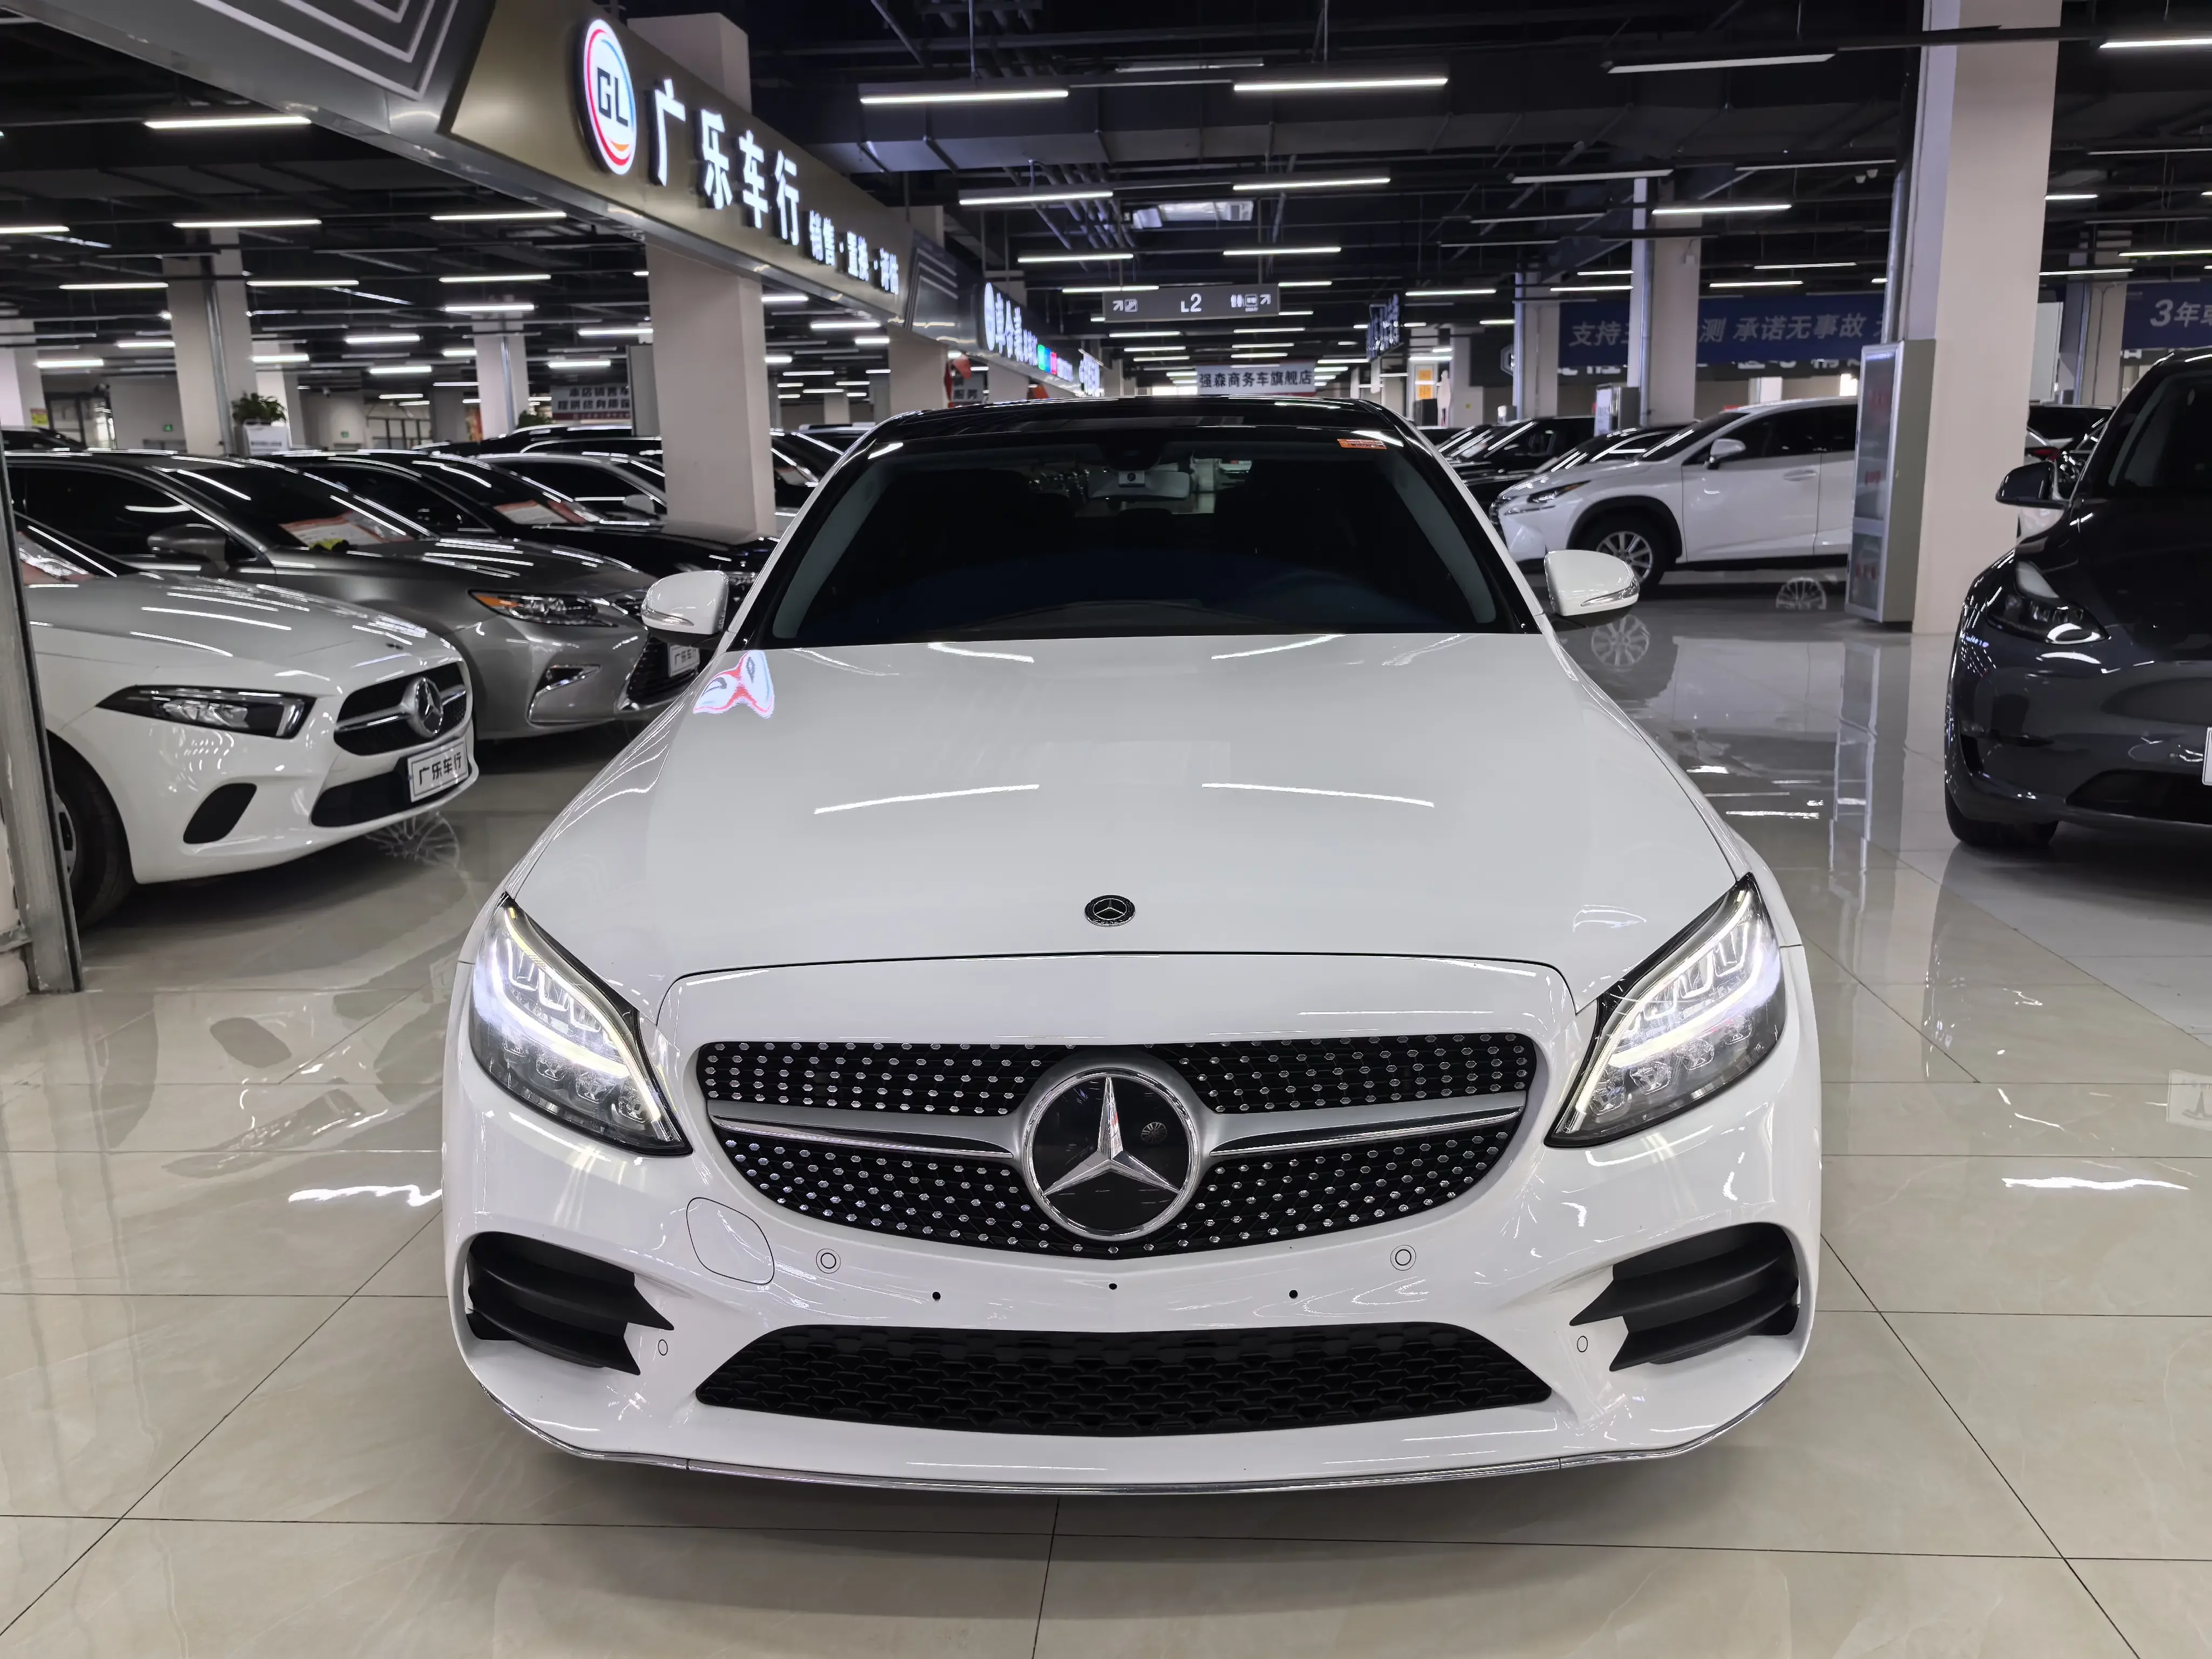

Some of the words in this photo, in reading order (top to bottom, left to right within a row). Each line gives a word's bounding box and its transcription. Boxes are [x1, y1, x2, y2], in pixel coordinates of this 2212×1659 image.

[597, 67, 629, 127] GL
[653, 78, 801, 246] 广乐车行
[1180, 293, 1203, 313] L2
[1732, 312, 1867, 342] 承诺无事故
[1198, 370, 1313, 388] 强森商务车旗舰店
[419, 751, 462, 786] 广乐车行
